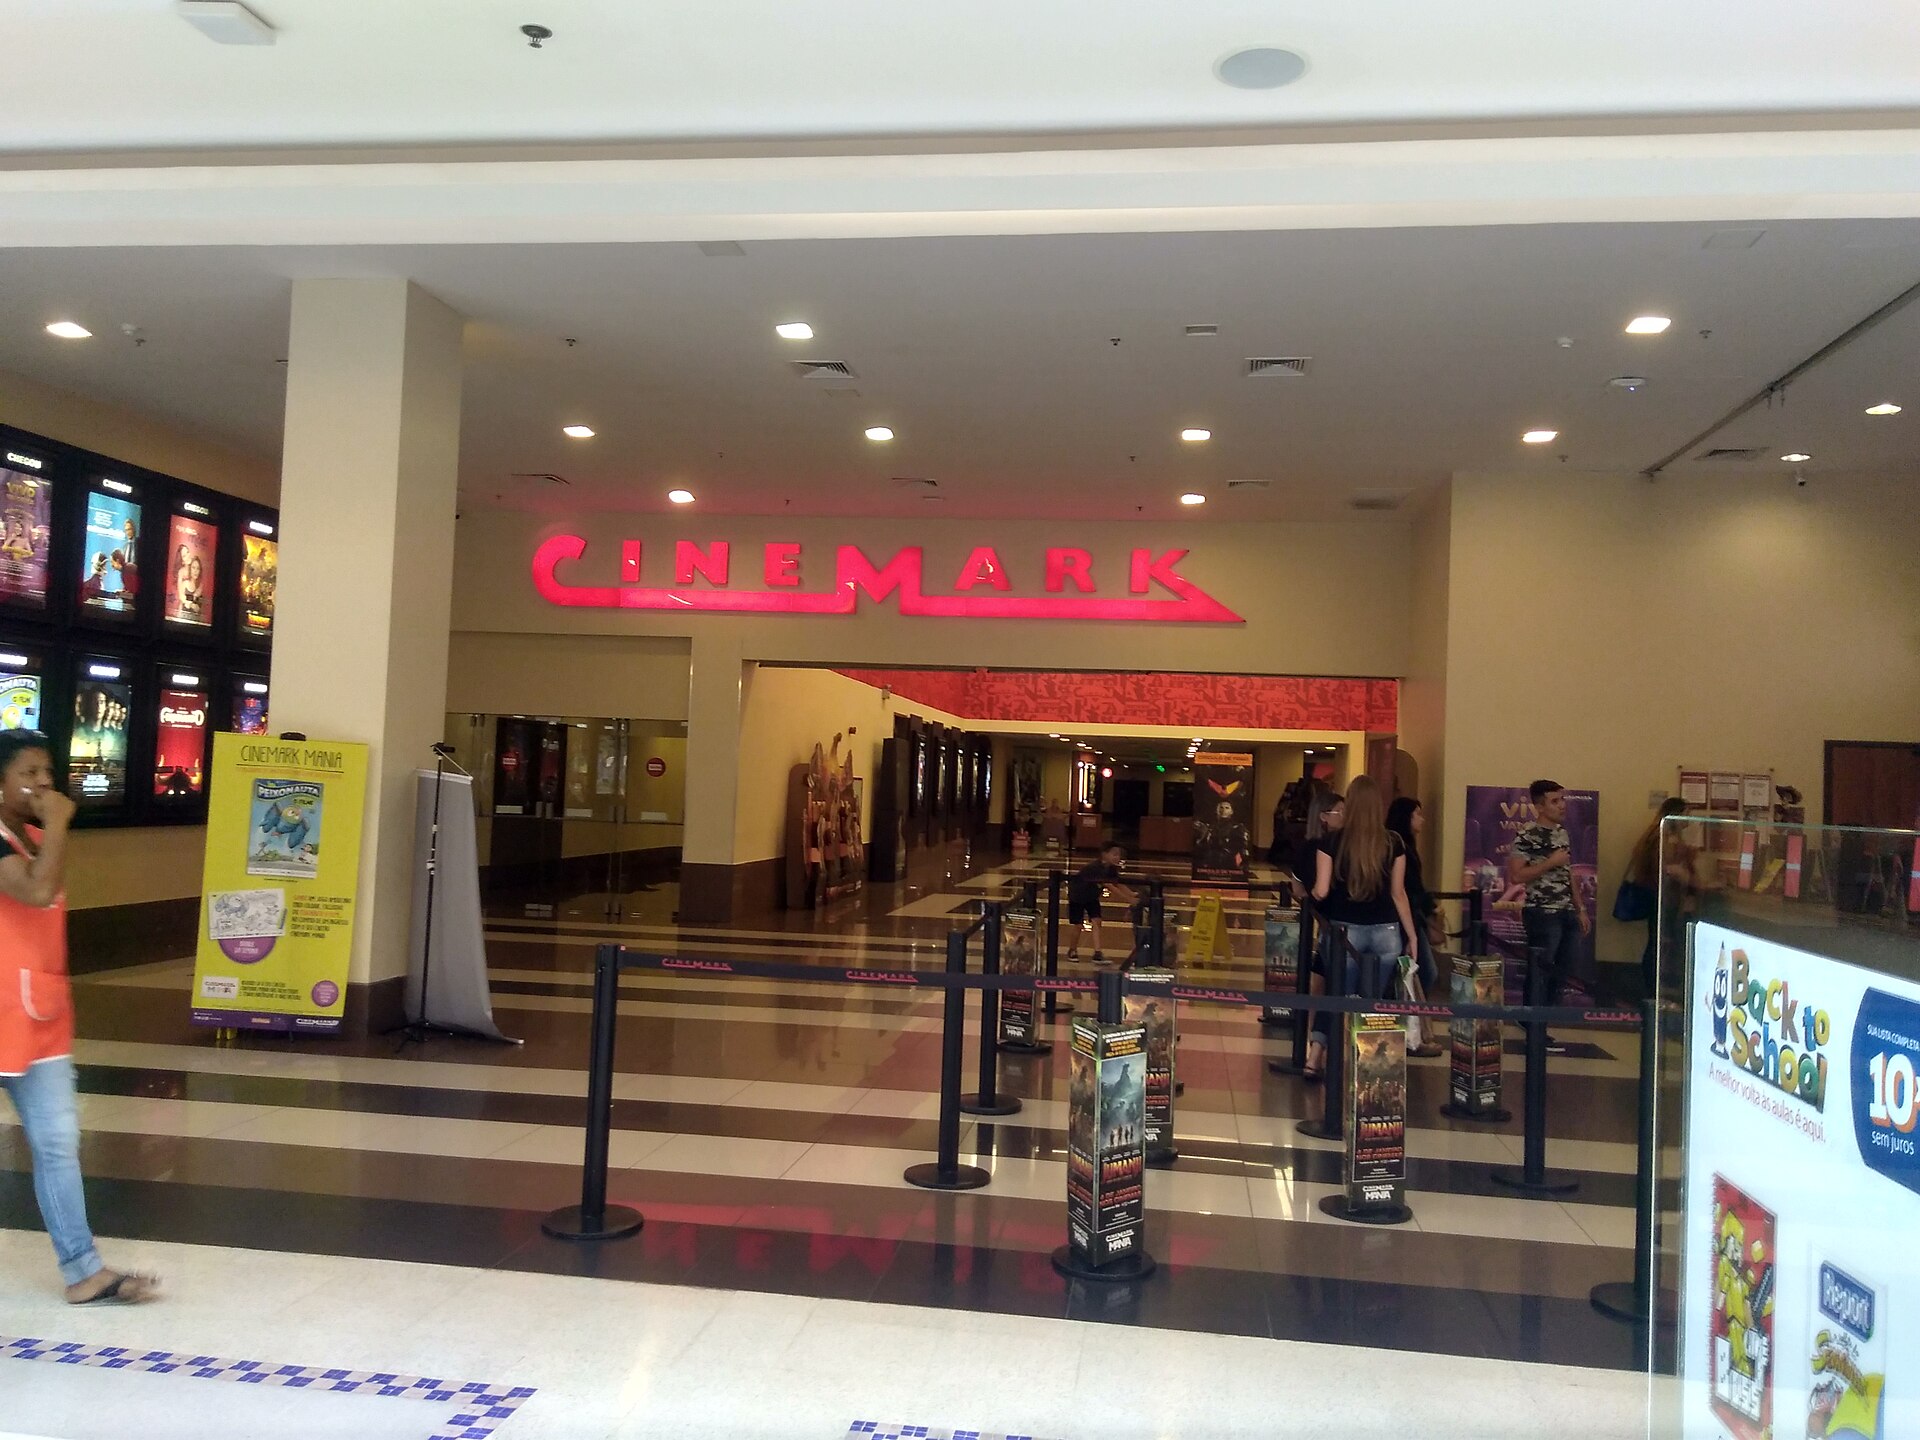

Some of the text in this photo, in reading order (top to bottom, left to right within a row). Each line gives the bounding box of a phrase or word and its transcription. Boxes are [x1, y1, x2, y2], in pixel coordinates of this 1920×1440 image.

[532, 534, 1246, 622] CINEMARK
[240, 745, 342, 769] CINEMARK MANIA
[258, 784, 320, 799] PEIXONAUTA
[662, 957, 733, 971] CINEMARK
[846, 970, 919, 983] CINEMARK
[1171, 987, 1249, 1002] CINEMARK
[1731, 948, 1830, 1052] Back to
[1374, 1002, 1455, 1015] CINEMARK
[1867, 1023, 1920, 1052] SUA LISTA COMPLETA
[1729, 1006, 1828, 1114] School
[1709, 1061, 1716, 1079] A
[1715, 1067, 1740, 1093] melhor
[1741, 1081, 1760, 1105] volta
[1772, 1099, 1794, 1125] aulas
[1795, 1109, 1802, 1128] é
[1802, 1116, 1826, 1143] aqui.
[1871, 1130, 1915, 1156] sem juros
